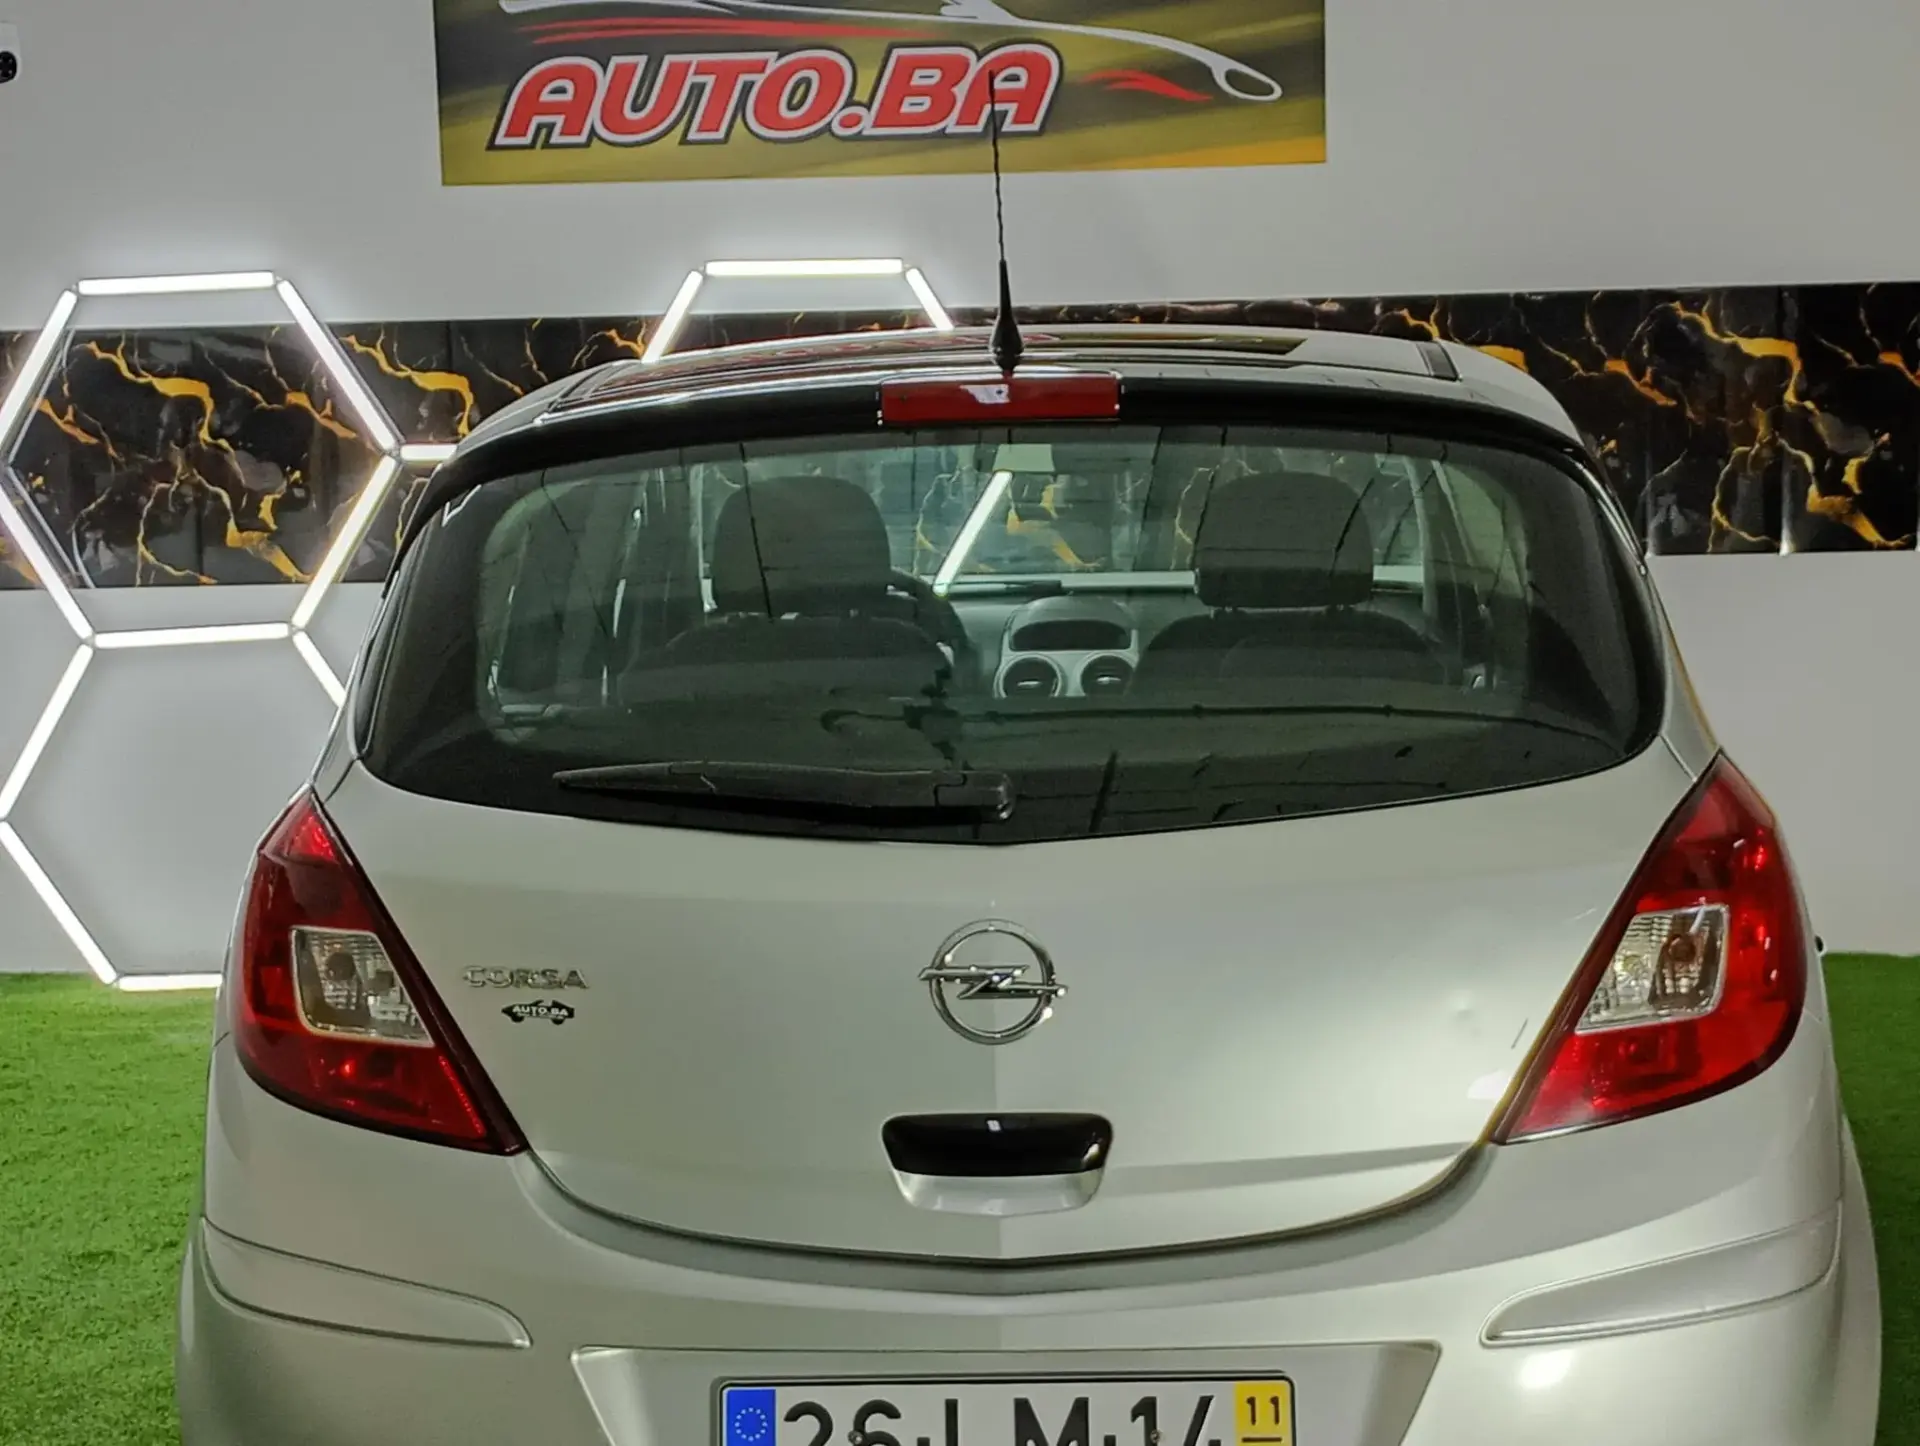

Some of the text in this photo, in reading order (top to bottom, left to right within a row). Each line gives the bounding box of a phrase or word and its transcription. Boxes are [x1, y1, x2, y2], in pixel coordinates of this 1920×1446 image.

[489, 41, 1062, 150] AUTO.BA
[463, 965, 590, 989] CORSA
[1246, 1396, 1280, 1425] 11
